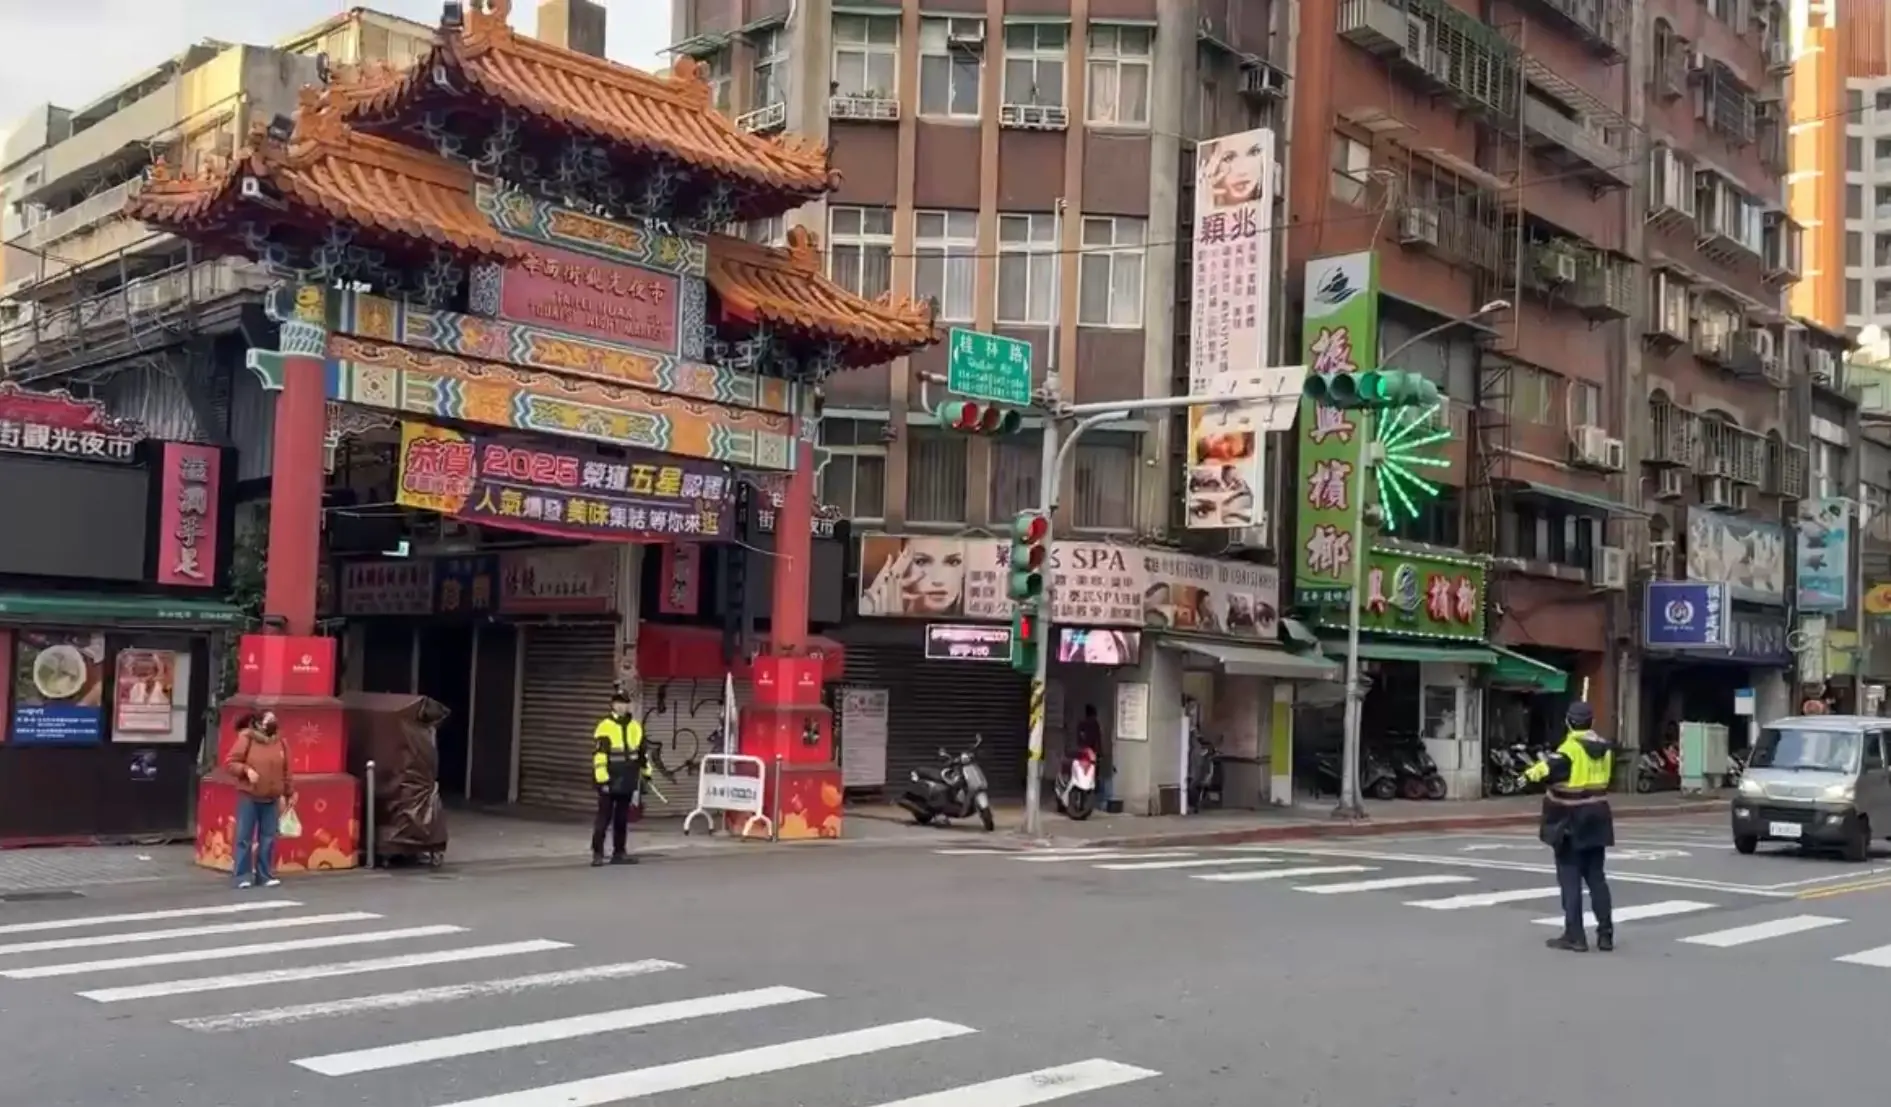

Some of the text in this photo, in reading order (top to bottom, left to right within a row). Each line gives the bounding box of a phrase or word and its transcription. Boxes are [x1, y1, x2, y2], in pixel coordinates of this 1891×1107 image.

[959, 333, 1024, 363] 桂林路
[483, 444, 581, 488] 2025
[1071, 547, 1126, 571] SPA
